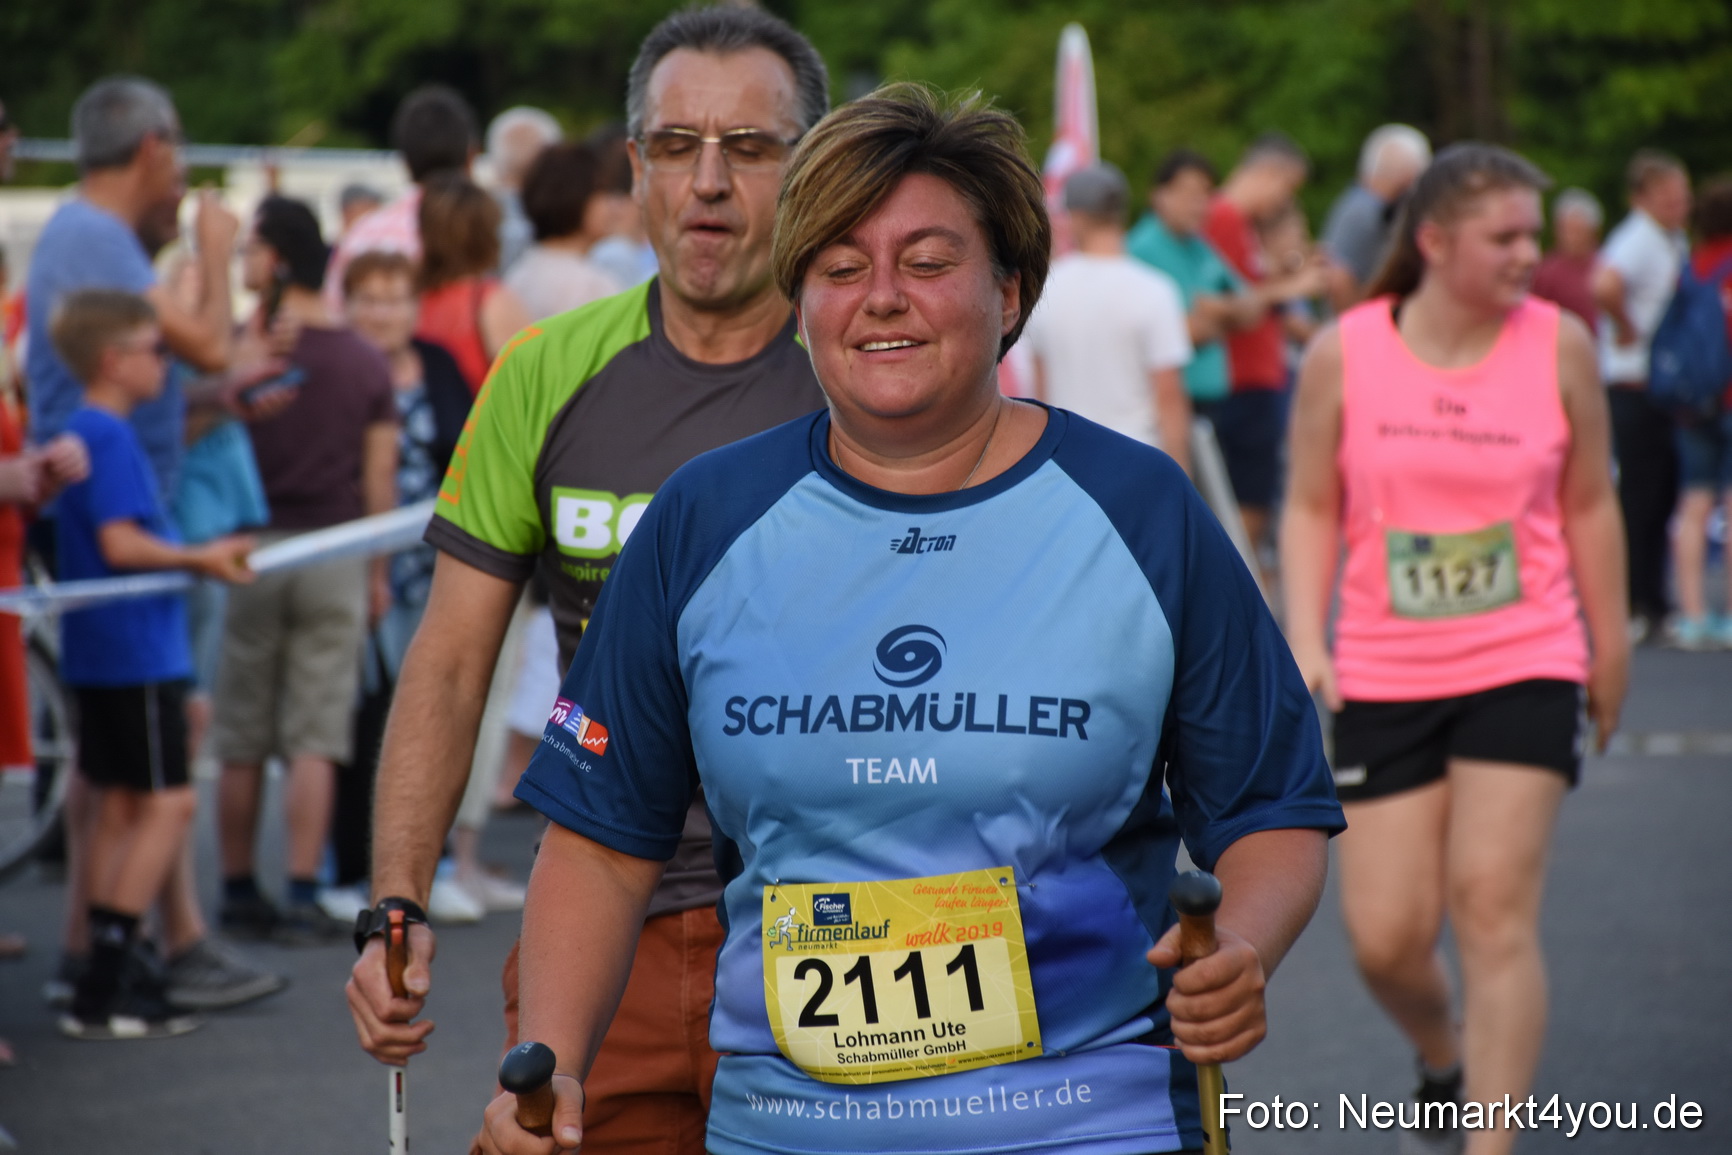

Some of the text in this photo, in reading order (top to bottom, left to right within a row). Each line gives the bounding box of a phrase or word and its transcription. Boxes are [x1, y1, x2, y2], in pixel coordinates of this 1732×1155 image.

[1406, 552, 1502, 597] 1127
[722, 692, 1091, 740] SCHABMÜLLER
[846, 758, 938, 784] TEAM
[913, 883, 998, 895] Gesunde Firmen
[819, 901, 846, 911] Fischer
[935, 896, 968, 910] laufen
[797, 919, 891, 941] firmenlauf
[905, 921, 1003, 947] walk 2019
[798, 942, 838, 951] neumarkt
[793, 944, 984, 1028] 2111
[833, 1021, 967, 1049] Lohmann Ute
[837, 1040, 967, 1064] Schabmüller GmbH
[746, 1079, 1092, 1120] www.schabmueller.de
